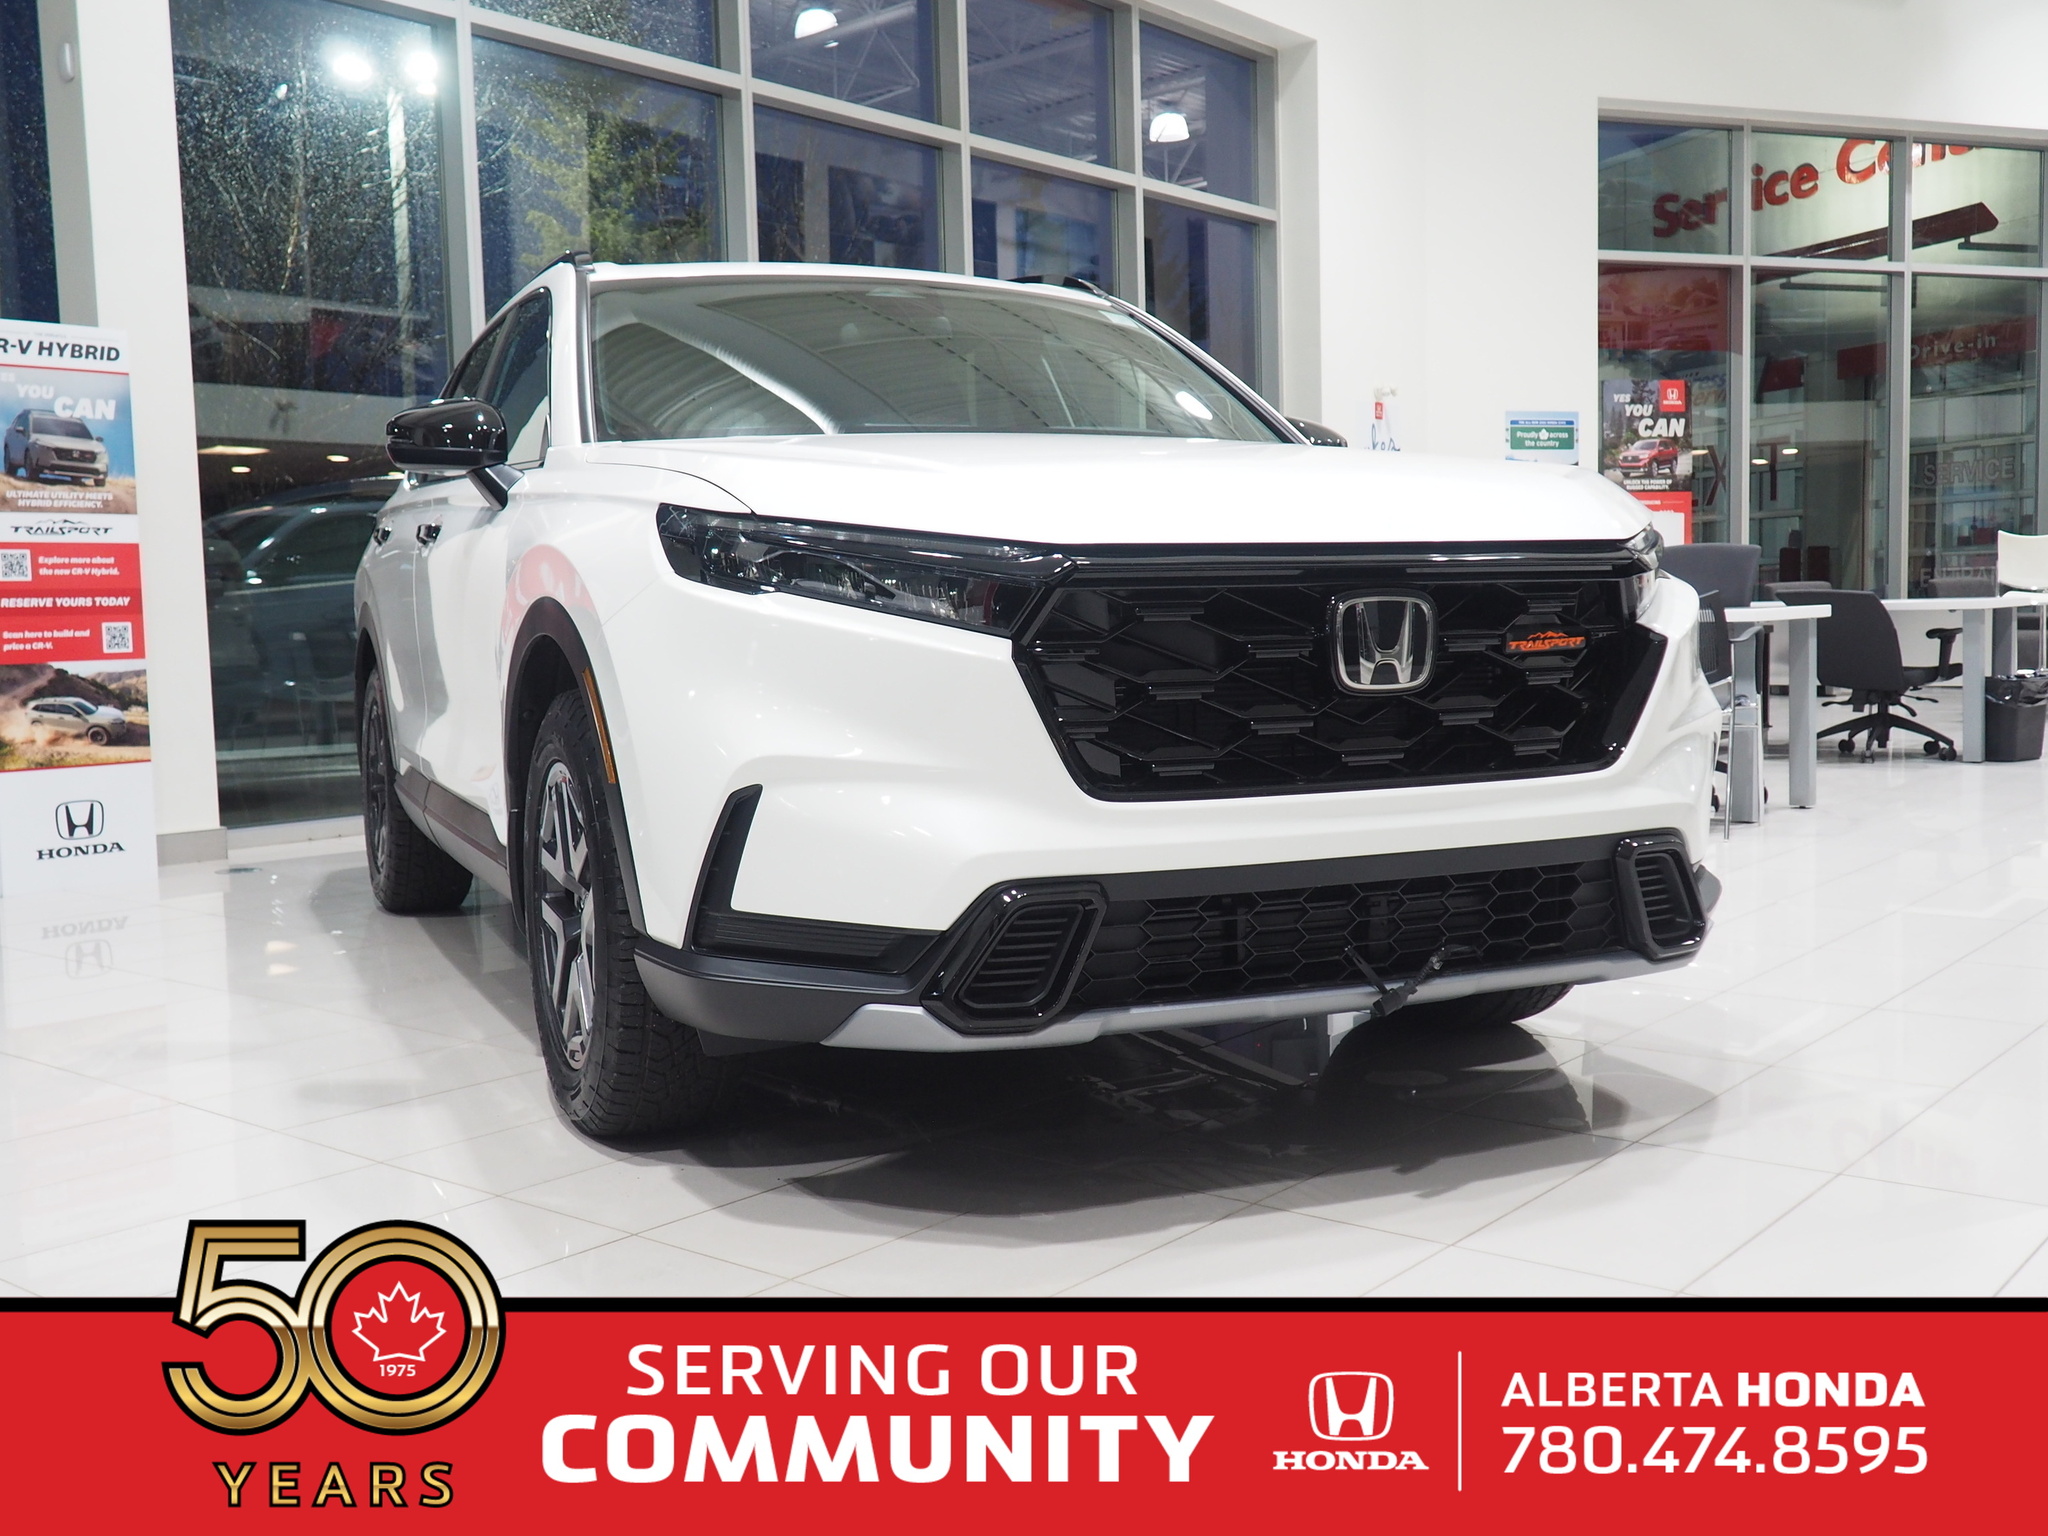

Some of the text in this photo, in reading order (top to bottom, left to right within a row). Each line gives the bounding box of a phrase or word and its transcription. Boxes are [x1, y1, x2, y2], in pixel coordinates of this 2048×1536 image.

[1653, 162, 1819, 239] Serice
[37, 340, 121, 361] HYBRID
[16, 384, 55, 400] YOU
[1613, 393, 1631, 403] YES
[54, 396, 117, 420] CAN
[1624, 404, 1653, 417] YOU
[1638, 418, 1686, 438] CAN
[1516, 430, 1539, 439] Proudly
[1536, 440, 1560, 448] country
[1923, 456, 2016, 486] SERVICE
[6, 490, 113, 500] ULTIMATE UTILITY MEETS
[18, 499, 53, 507] HYBRID
[10, 525, 113, 536] TRAILSPORT
[38, 555, 70, 565] Explore
[91, 556, 115, 564] about
[39, 567, 53, 576] the
[54, 568, 71, 576] new
[1, 596, 131, 608] RESERVE YOURS TODAY
[3, 628, 91, 639] Scan here to build and
[3, 642, 24, 652] price
[1508, 636, 1586, 651] TRAILSPORT
[37, 842, 125, 860] HONDA
